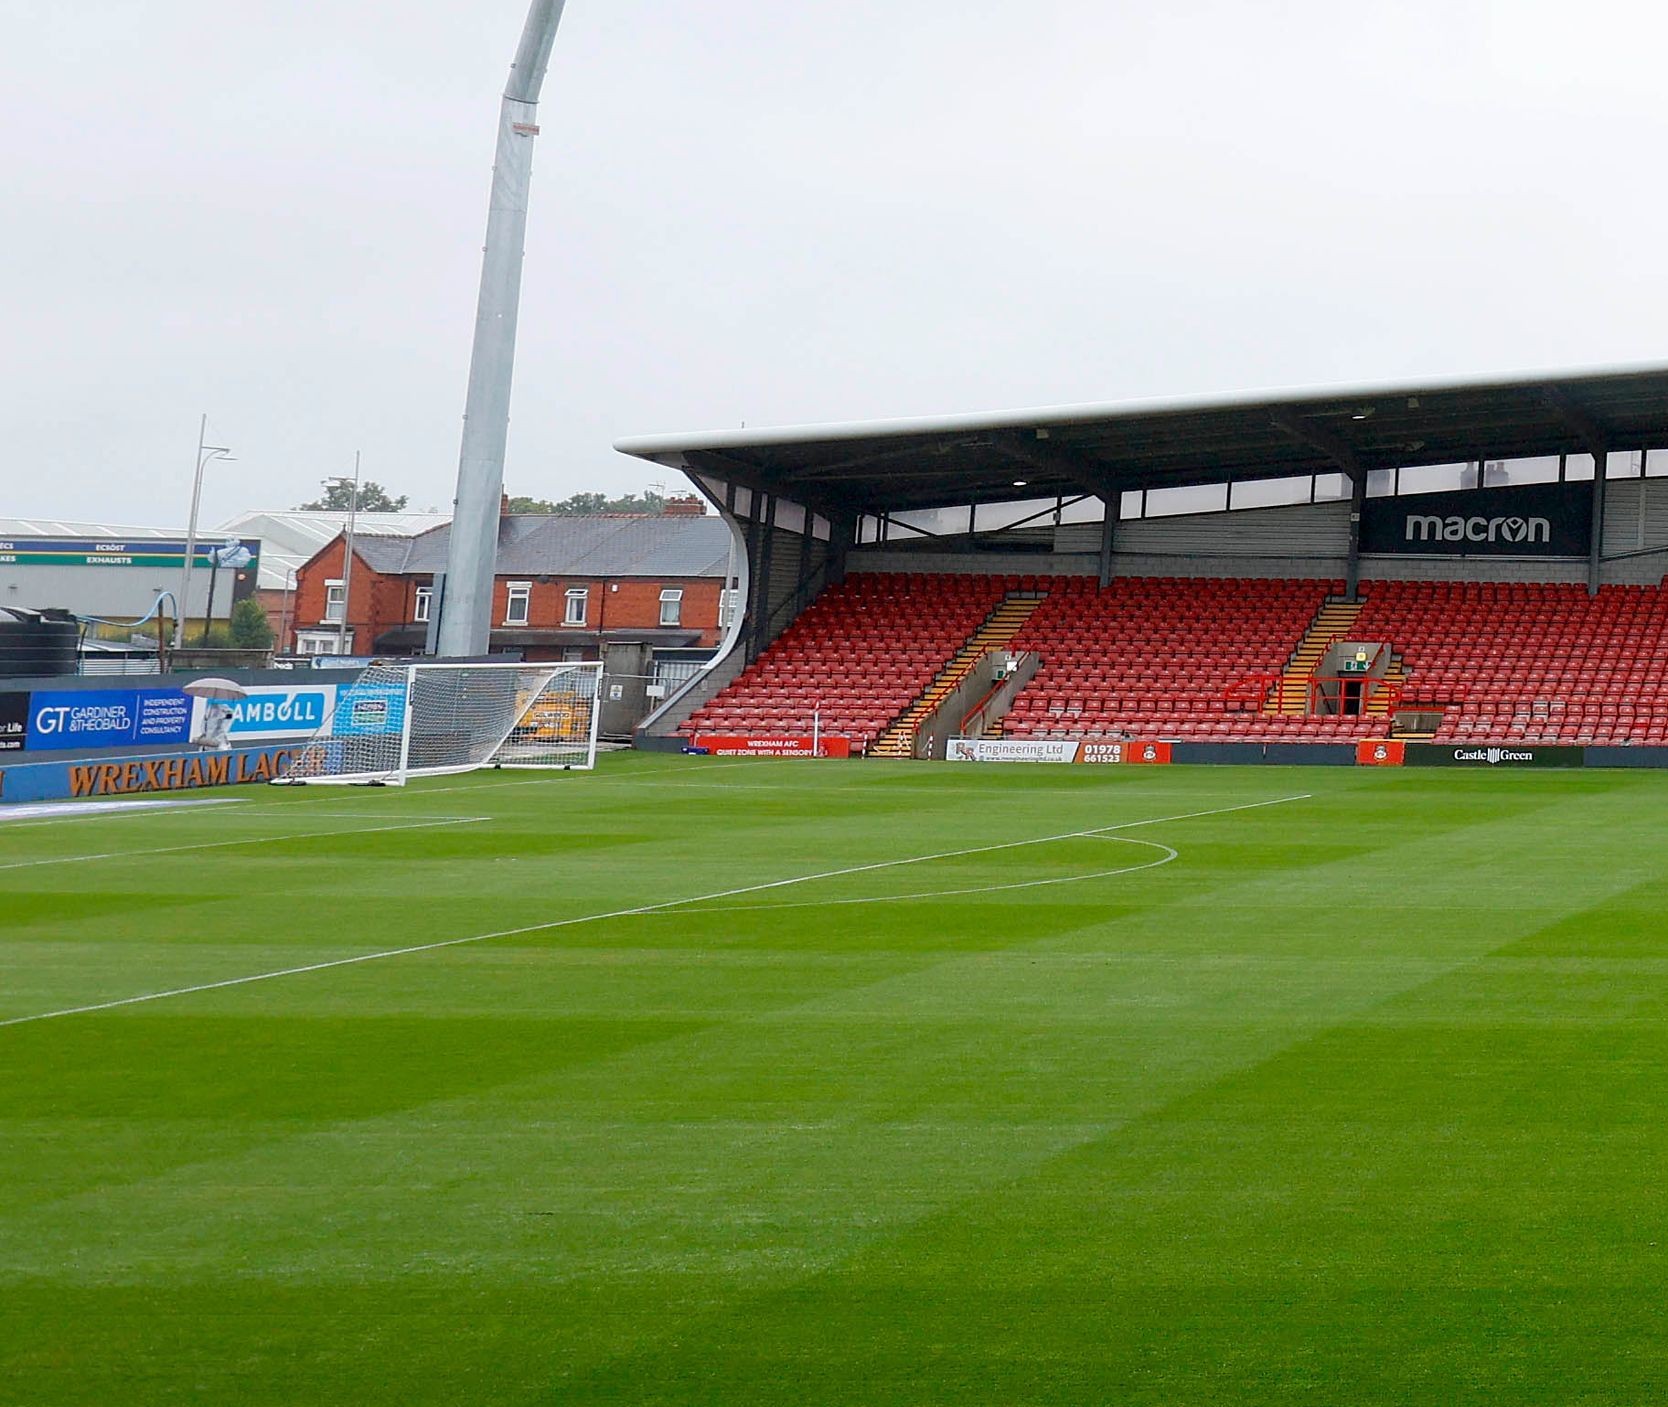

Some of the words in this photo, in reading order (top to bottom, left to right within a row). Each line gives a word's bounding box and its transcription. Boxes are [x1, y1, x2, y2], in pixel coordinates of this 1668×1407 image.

[1405, 514, 1550, 543] macron
[86, 556, 133, 565] EXHAUSTS
[71, 705, 127, 720] GARDINER
[232, 694, 316, 723] AMBOLL
[7, 722, 23, 732] Life
[36, 707, 70, 734] GT
[69, 717, 131, 732] &THEOBALD
[979, 743, 1044, 757] Engineering
[1046, 744, 1064, 754] Ltd
[1084, 744, 1121, 754] 01978
[1454, 748, 1487, 761] Castle
[1500, 749, 1533, 761] Green
[1084, 754, 1121, 763] 661523
[68, 753, 232, 797] WREXHAM
